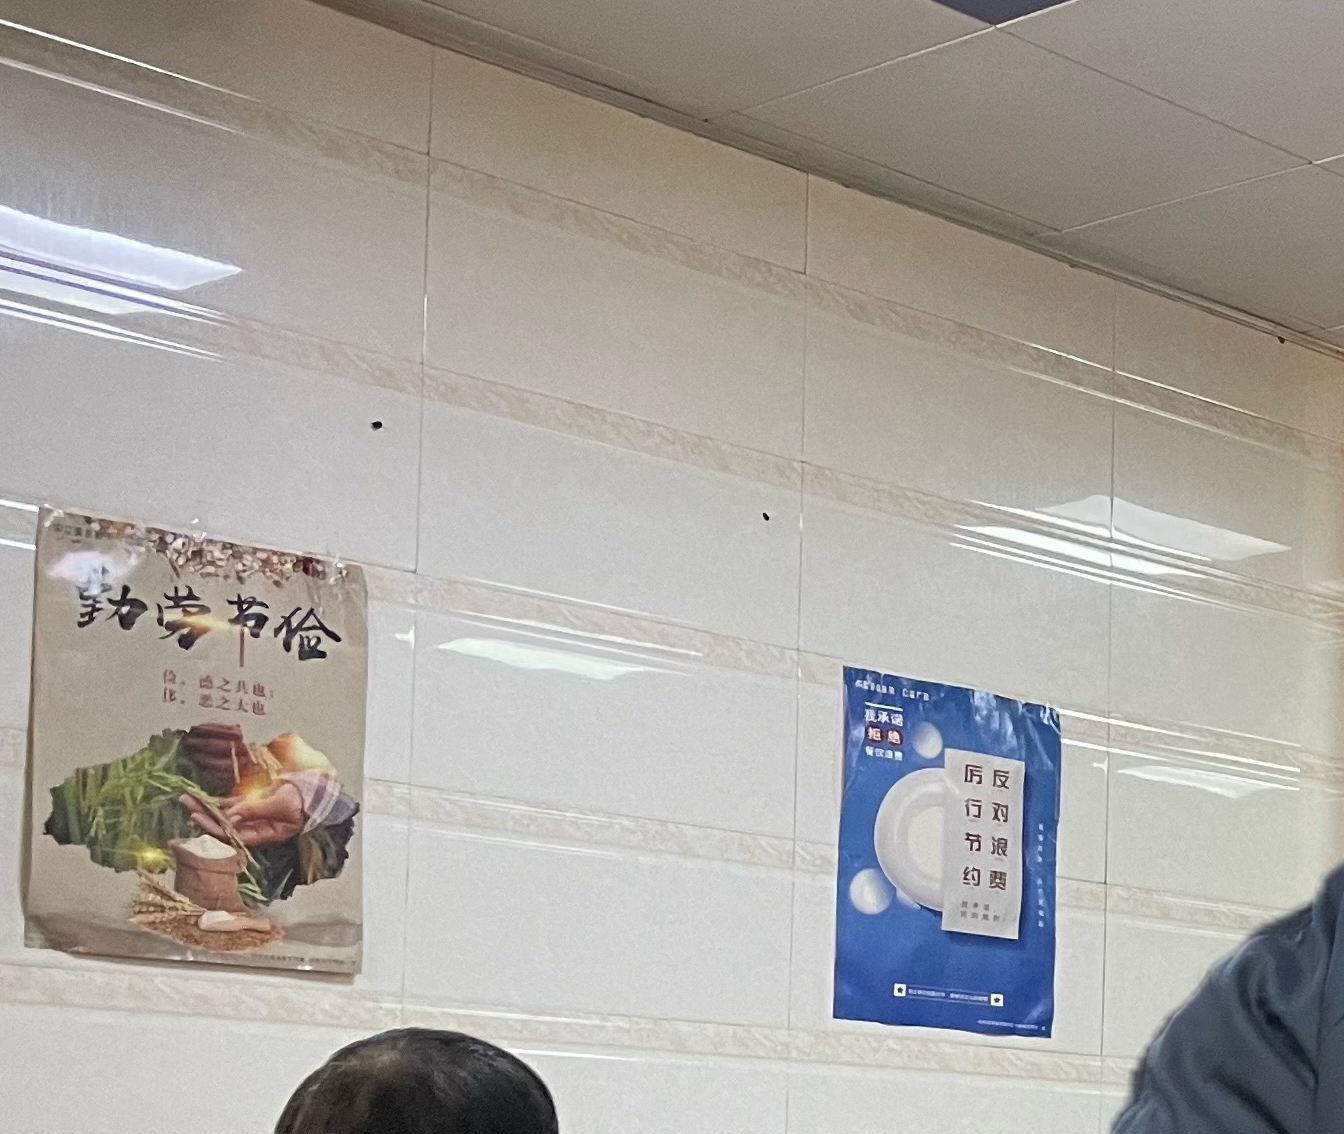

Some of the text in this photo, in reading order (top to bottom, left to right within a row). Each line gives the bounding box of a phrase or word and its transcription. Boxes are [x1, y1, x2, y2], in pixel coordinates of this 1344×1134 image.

[77, 571, 342, 660] 勤劳节俭
[962, 763, 984, 887] 厉行节约
[988, 769, 1010, 891] 反对浪费
